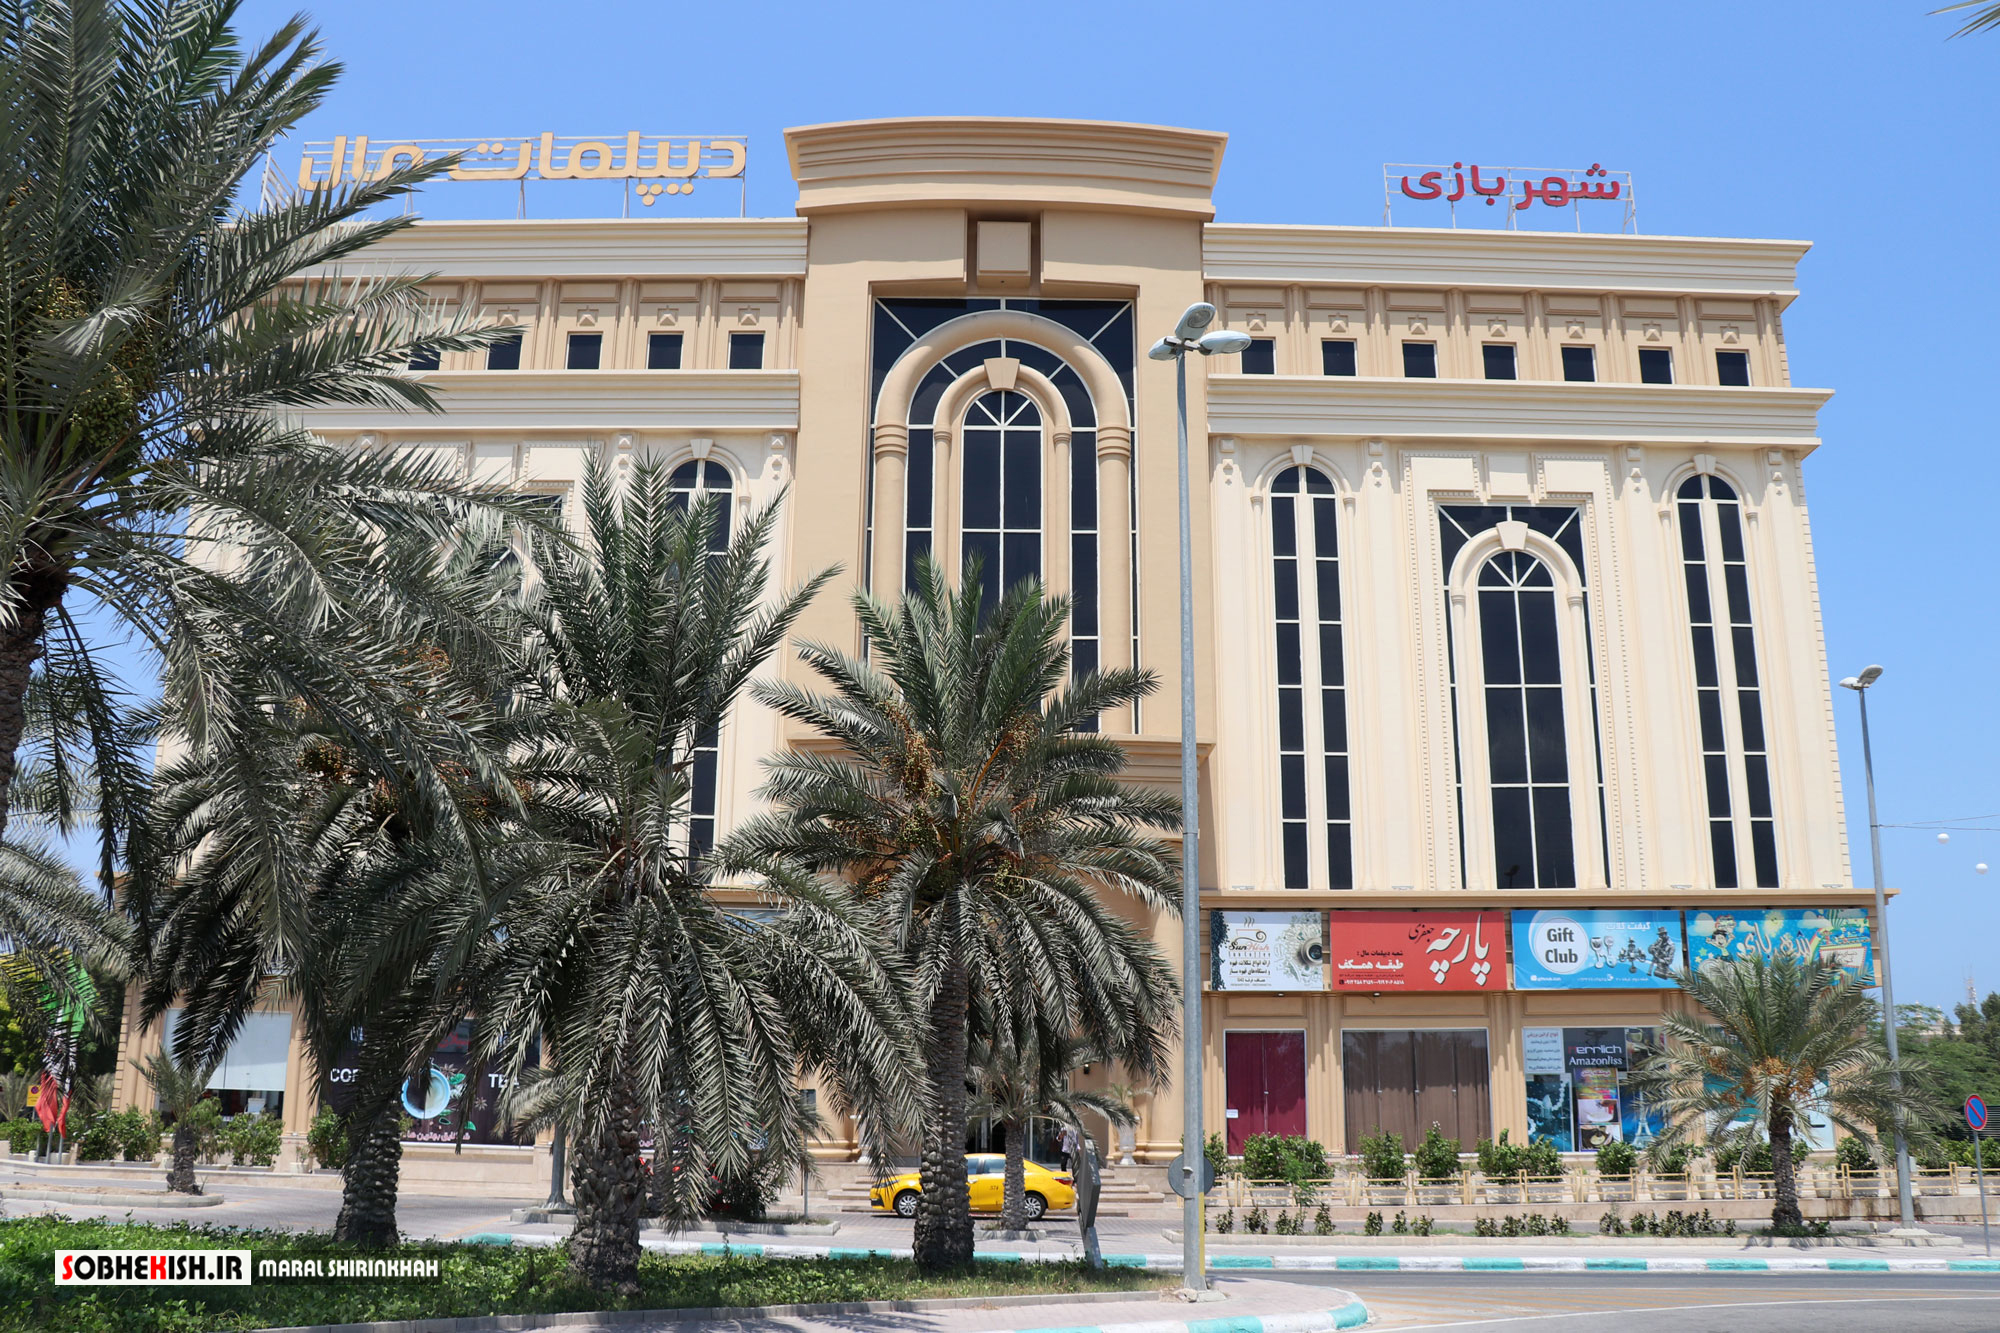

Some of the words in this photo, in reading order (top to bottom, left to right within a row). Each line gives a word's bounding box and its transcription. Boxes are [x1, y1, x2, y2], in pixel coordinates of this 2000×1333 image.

[1546, 927, 1575, 943] Gift
[1426, 913, 1491, 986] پارچه
[1545, 948, 1579, 964] Club
[1337, 958, 1374, 970] همکف
[1375, 959, 1405, 972] طبقه
[1568, 1055, 1623, 1066] Amazonliss
